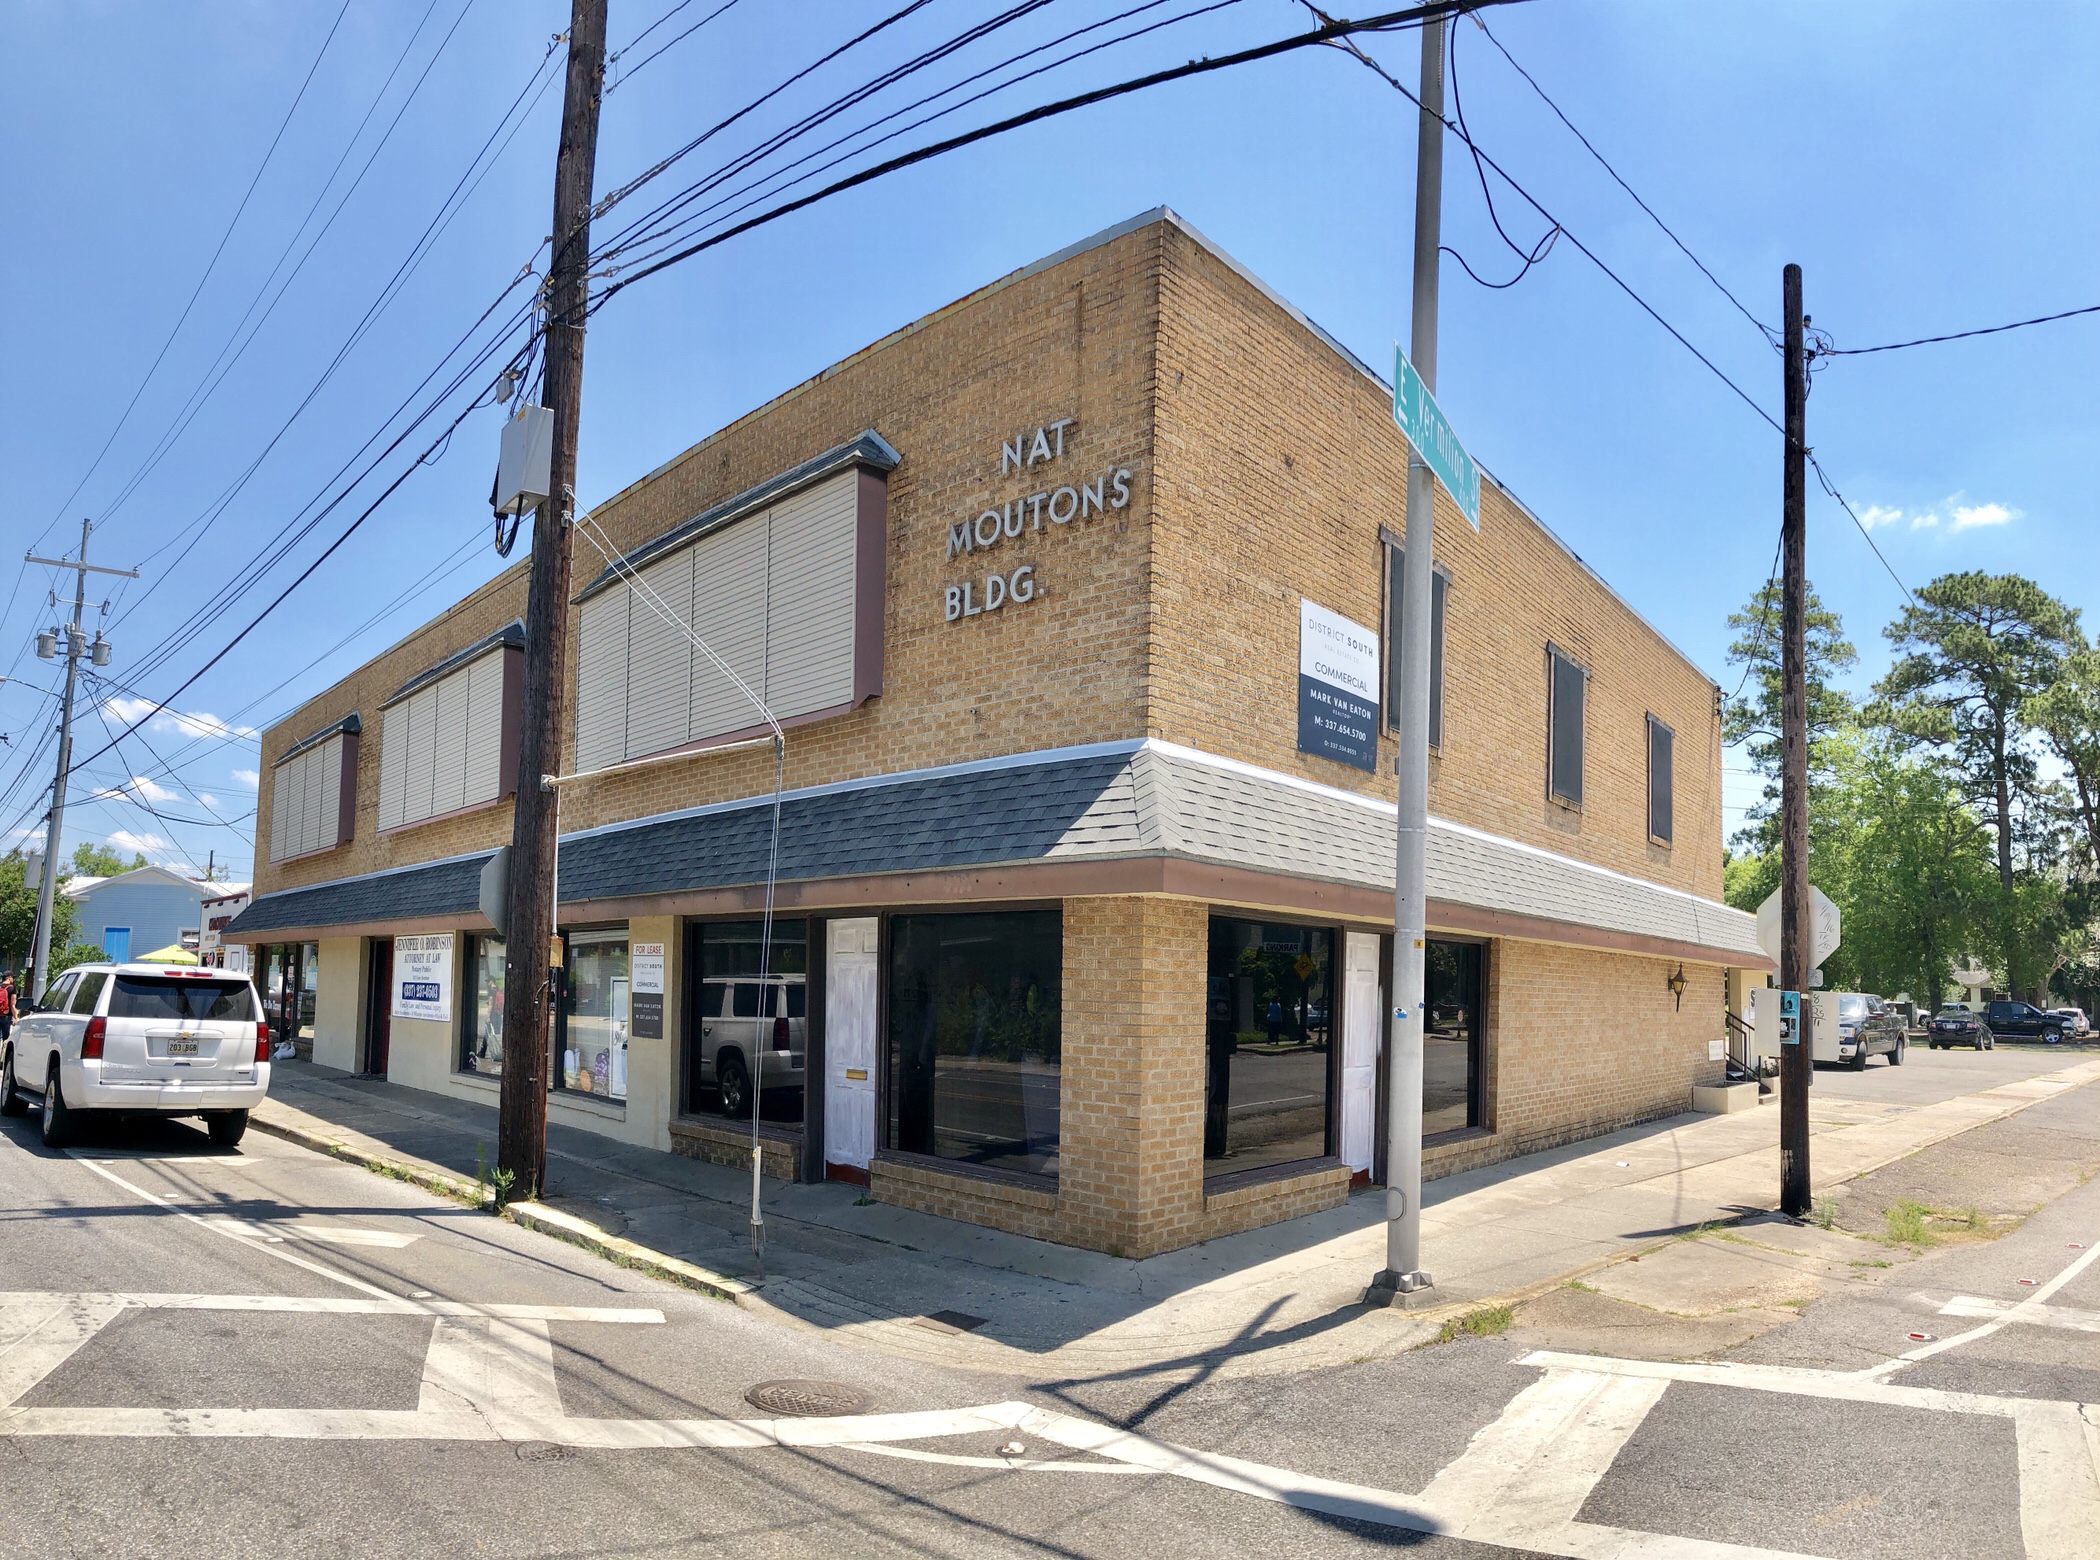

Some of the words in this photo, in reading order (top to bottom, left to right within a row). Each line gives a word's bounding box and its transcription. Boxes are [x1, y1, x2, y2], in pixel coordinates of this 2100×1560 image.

[1401, 357, 1407, 406] E
[1002, 418, 1073, 474] NAT
[1411, 418, 1424, 453] 300
[946, 465, 1132, 557] MOUTON'S
[945, 565, 1045, 622] BLDG.
[1309, 618, 1345, 643] DISTRICT
[1347, 636, 1373, 658] SOUTH
[1315, 661, 1368, 693] COMMERCIAL
[1310, 688, 1332, 705] MARK
[1333, 697, 1348, 711] VAN
[1349, 703, 1372, 720] EATON
[1314, 715, 1324, 727] M:
[1325, 719, 1367, 742] 337.654.5700
[404, 953, 425, 964] ATTORNEY
[432, 953, 441, 963] LAW
[636, 945, 645, 954] FOR
[647, 945, 662, 954] LEASE
[1812, 993, 1821, 1004] 8
[1812, 1007, 1825, 1018] 25
[169, 1043, 182, 1052] 203
